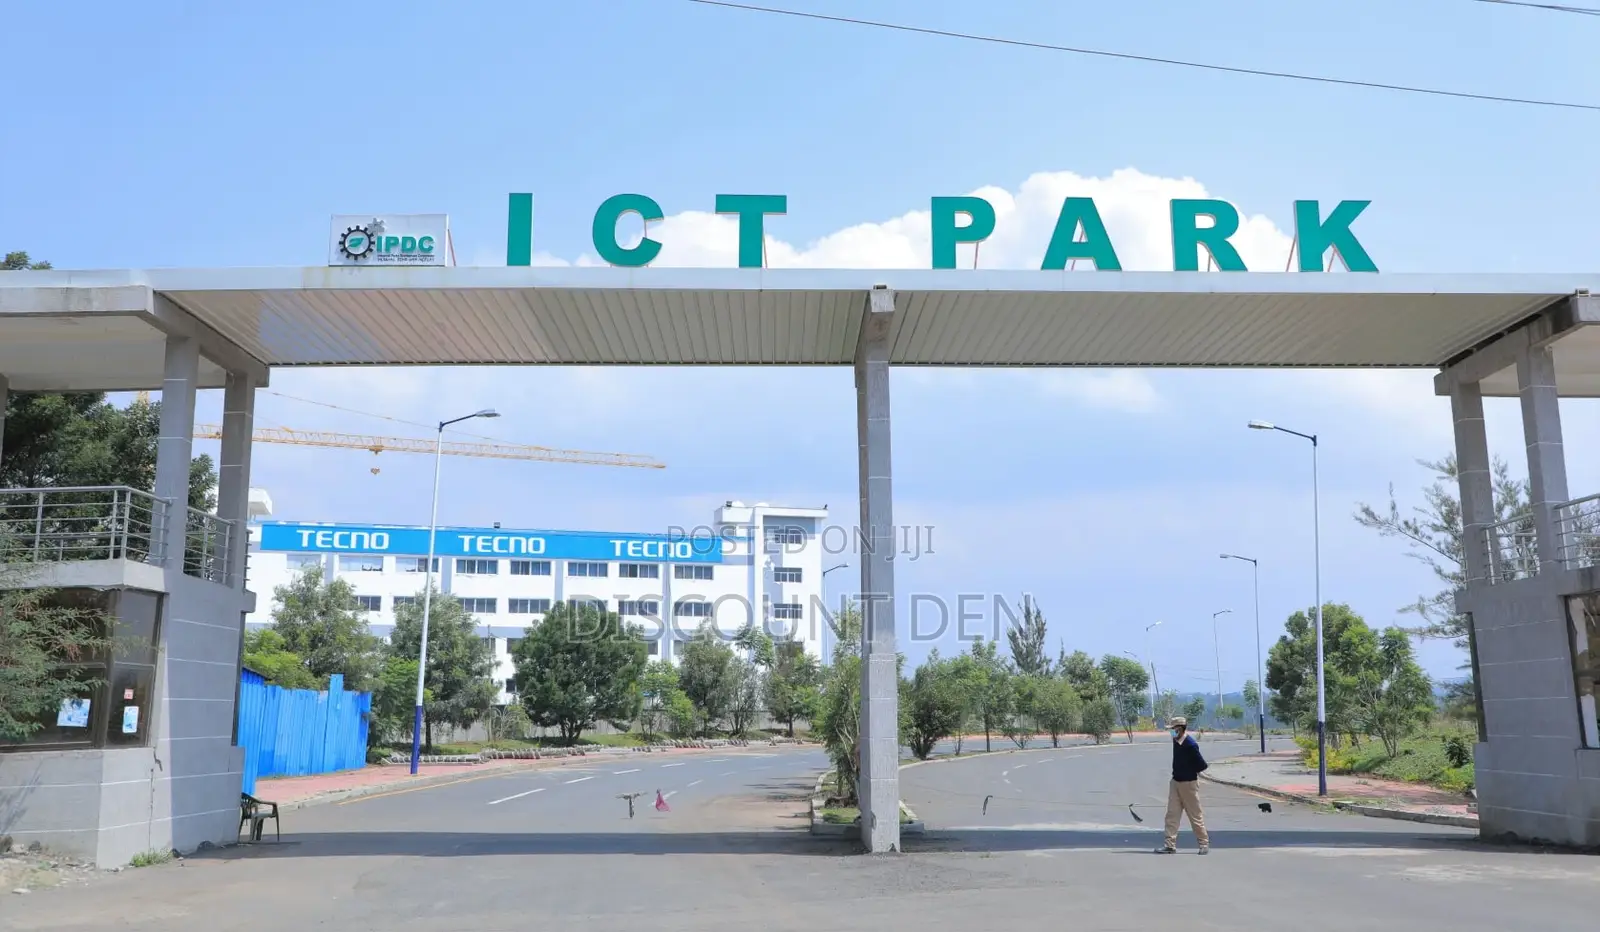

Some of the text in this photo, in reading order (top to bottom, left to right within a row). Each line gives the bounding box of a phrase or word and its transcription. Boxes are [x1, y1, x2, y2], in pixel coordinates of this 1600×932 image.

[377, 236, 434, 252] IPDC
[507, 193, 1379, 273] ICT PARK
[297, 530, 692, 558] TECNO TECNO TECNO
